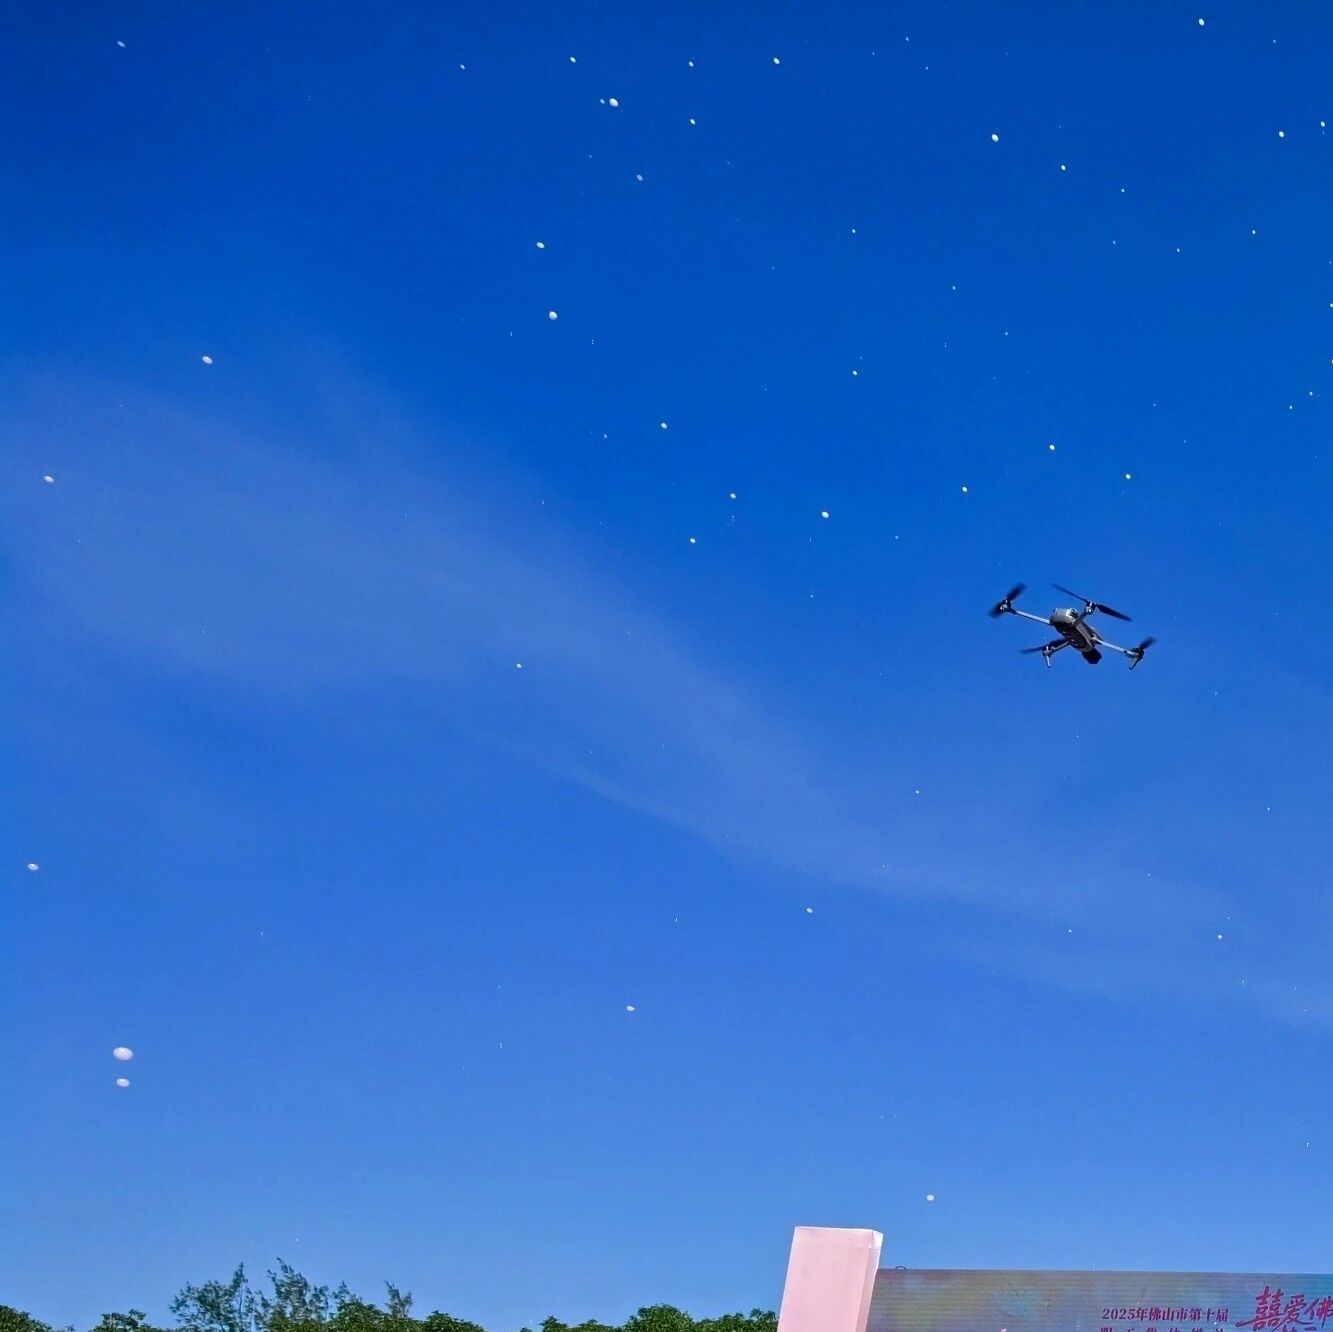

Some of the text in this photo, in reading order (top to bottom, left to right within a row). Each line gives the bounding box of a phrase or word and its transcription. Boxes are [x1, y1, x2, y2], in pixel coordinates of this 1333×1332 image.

[1102, 1307, 1228, 1322] 2025年佛山市第十届
